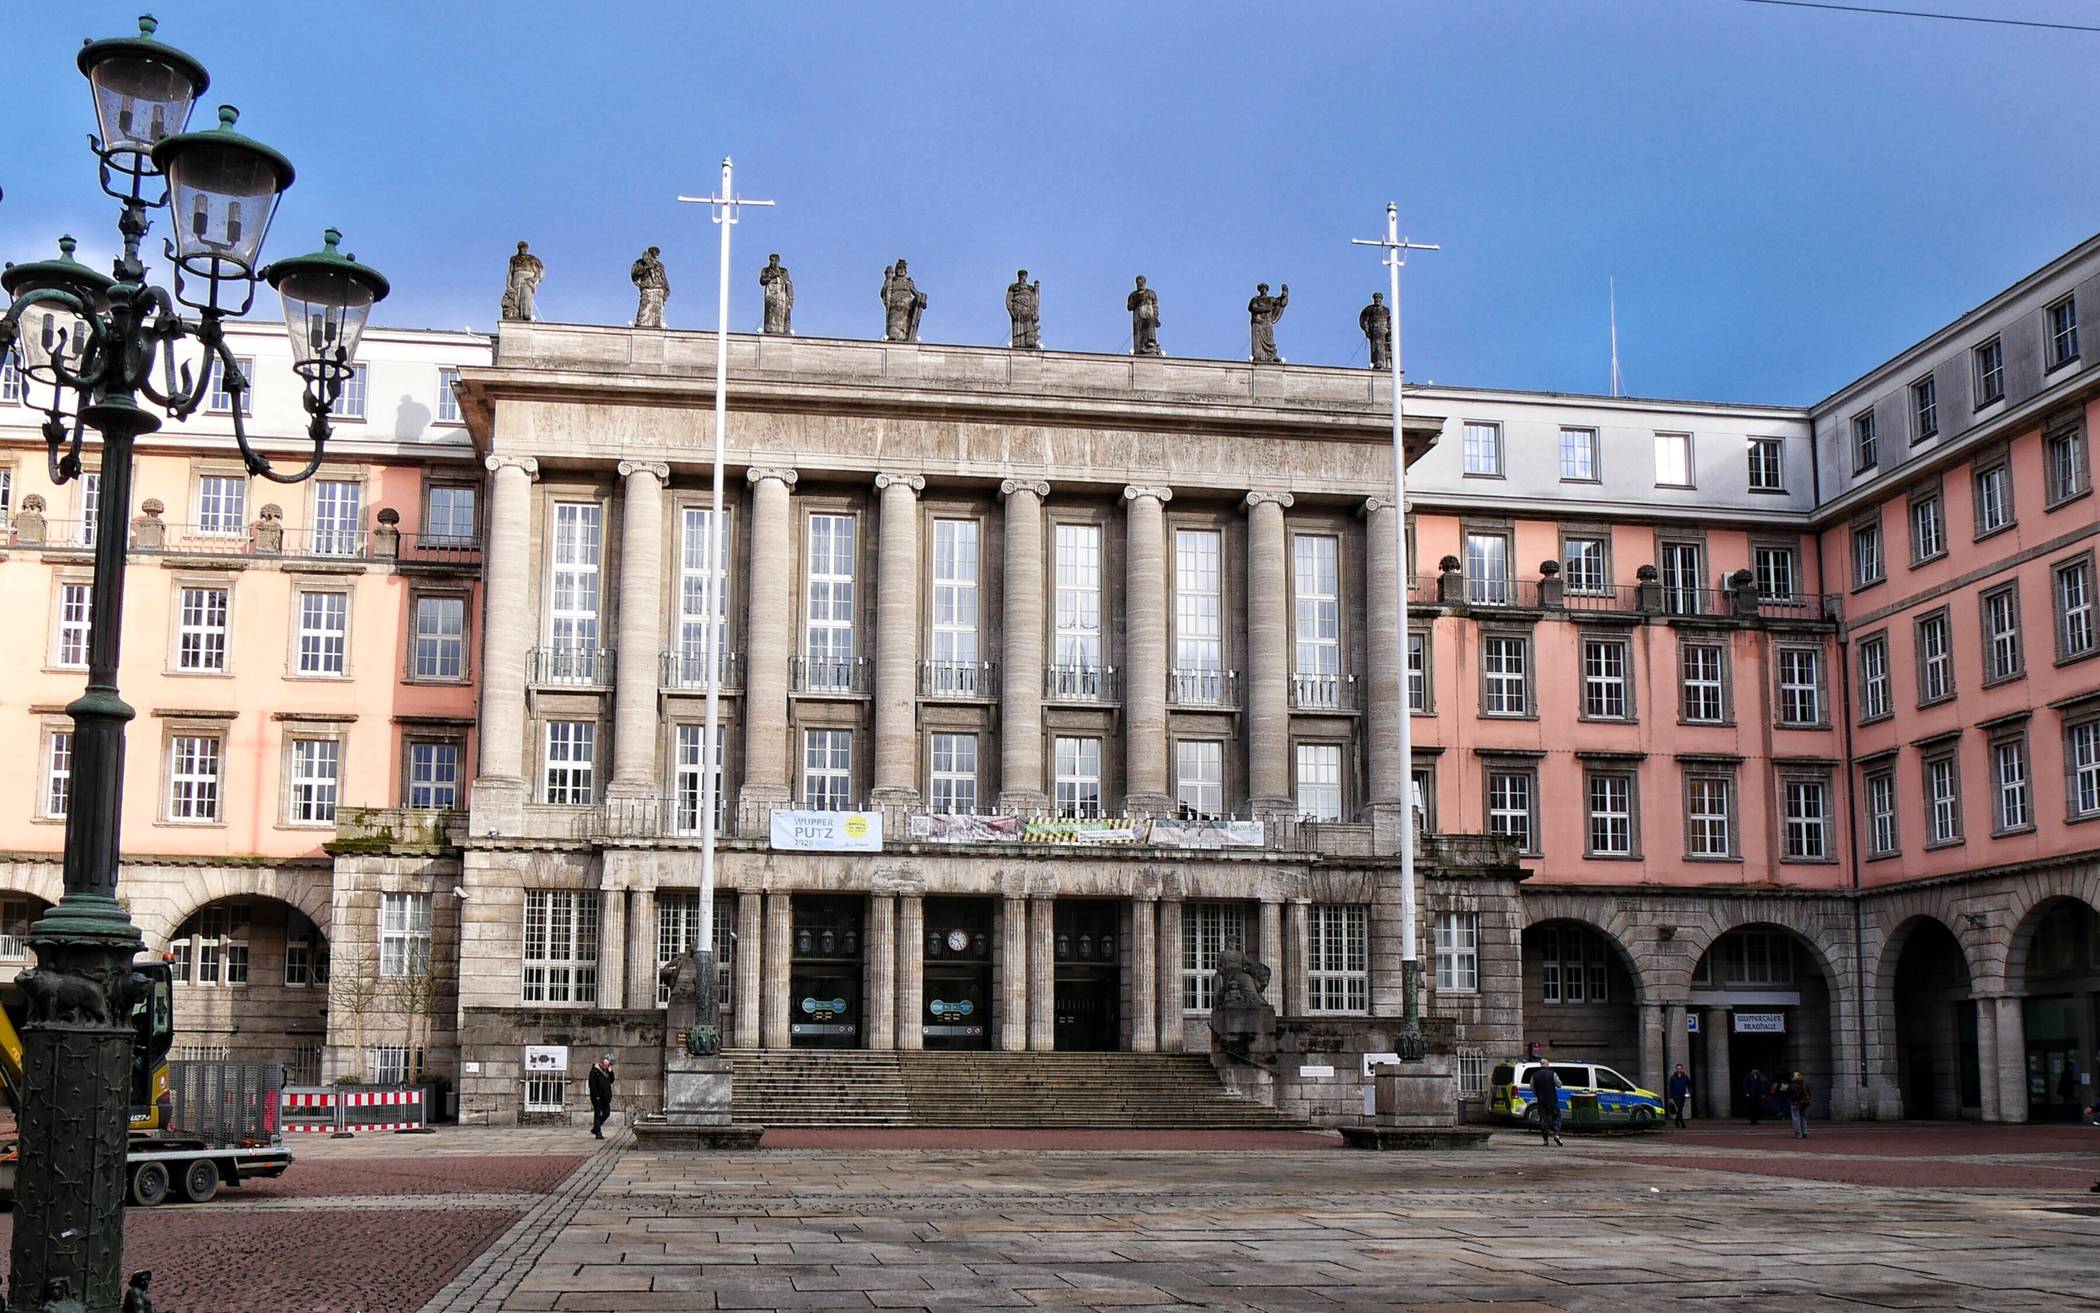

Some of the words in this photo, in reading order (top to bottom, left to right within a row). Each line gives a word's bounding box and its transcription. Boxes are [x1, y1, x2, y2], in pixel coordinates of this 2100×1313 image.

[794, 818, 834, 827] WUPPER
[795, 827, 834, 839] PUTZ
[1744, 1022, 1776, 1030] BRAUHAUS
